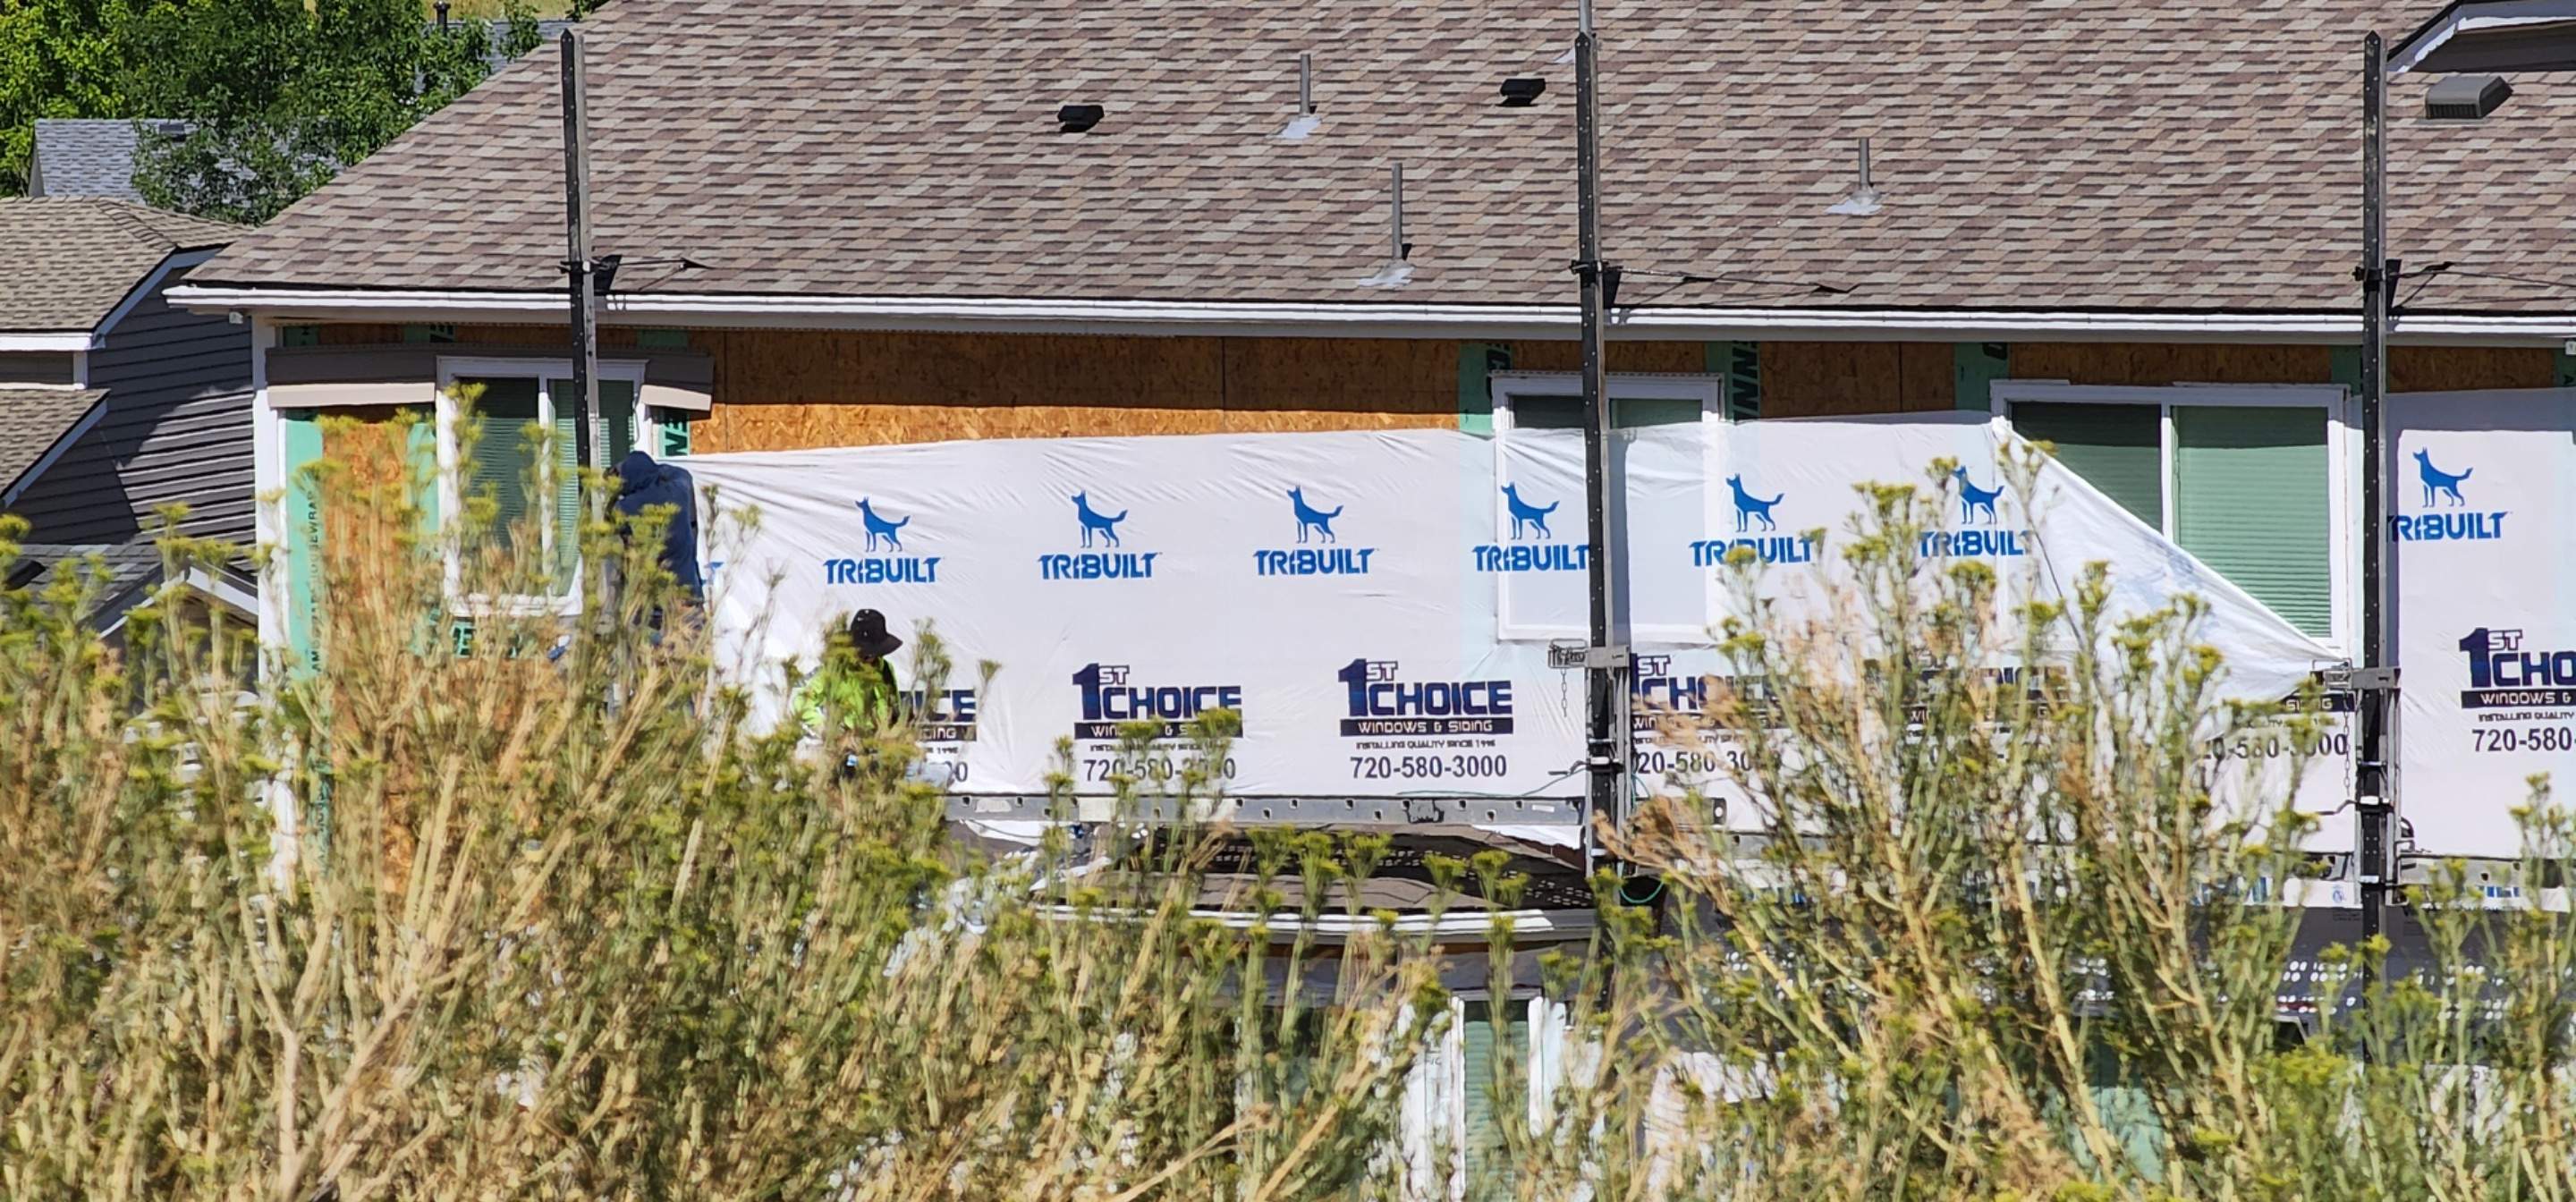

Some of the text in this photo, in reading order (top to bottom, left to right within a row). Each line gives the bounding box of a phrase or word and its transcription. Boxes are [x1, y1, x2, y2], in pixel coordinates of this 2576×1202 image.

[1252, 548, 1375, 575] TRIBUILT
[1471, 545, 1590, 571] TRIBUILT
[1689, 537, 1816, 567] TRUILT
[823, 556, 941, 584] TRIBUILT
[1038, 552, 1158, 580] TRIBUILT
[1368, 681, 1513, 716] CHOICE
[2480, 692, 2555, 705] WINDOWS
[1358, 721, 1427, 734] WINDOWS
[1448, 719, 1493, 732] SIDING
[1350, 755, 1507, 779] 720-580-3000
